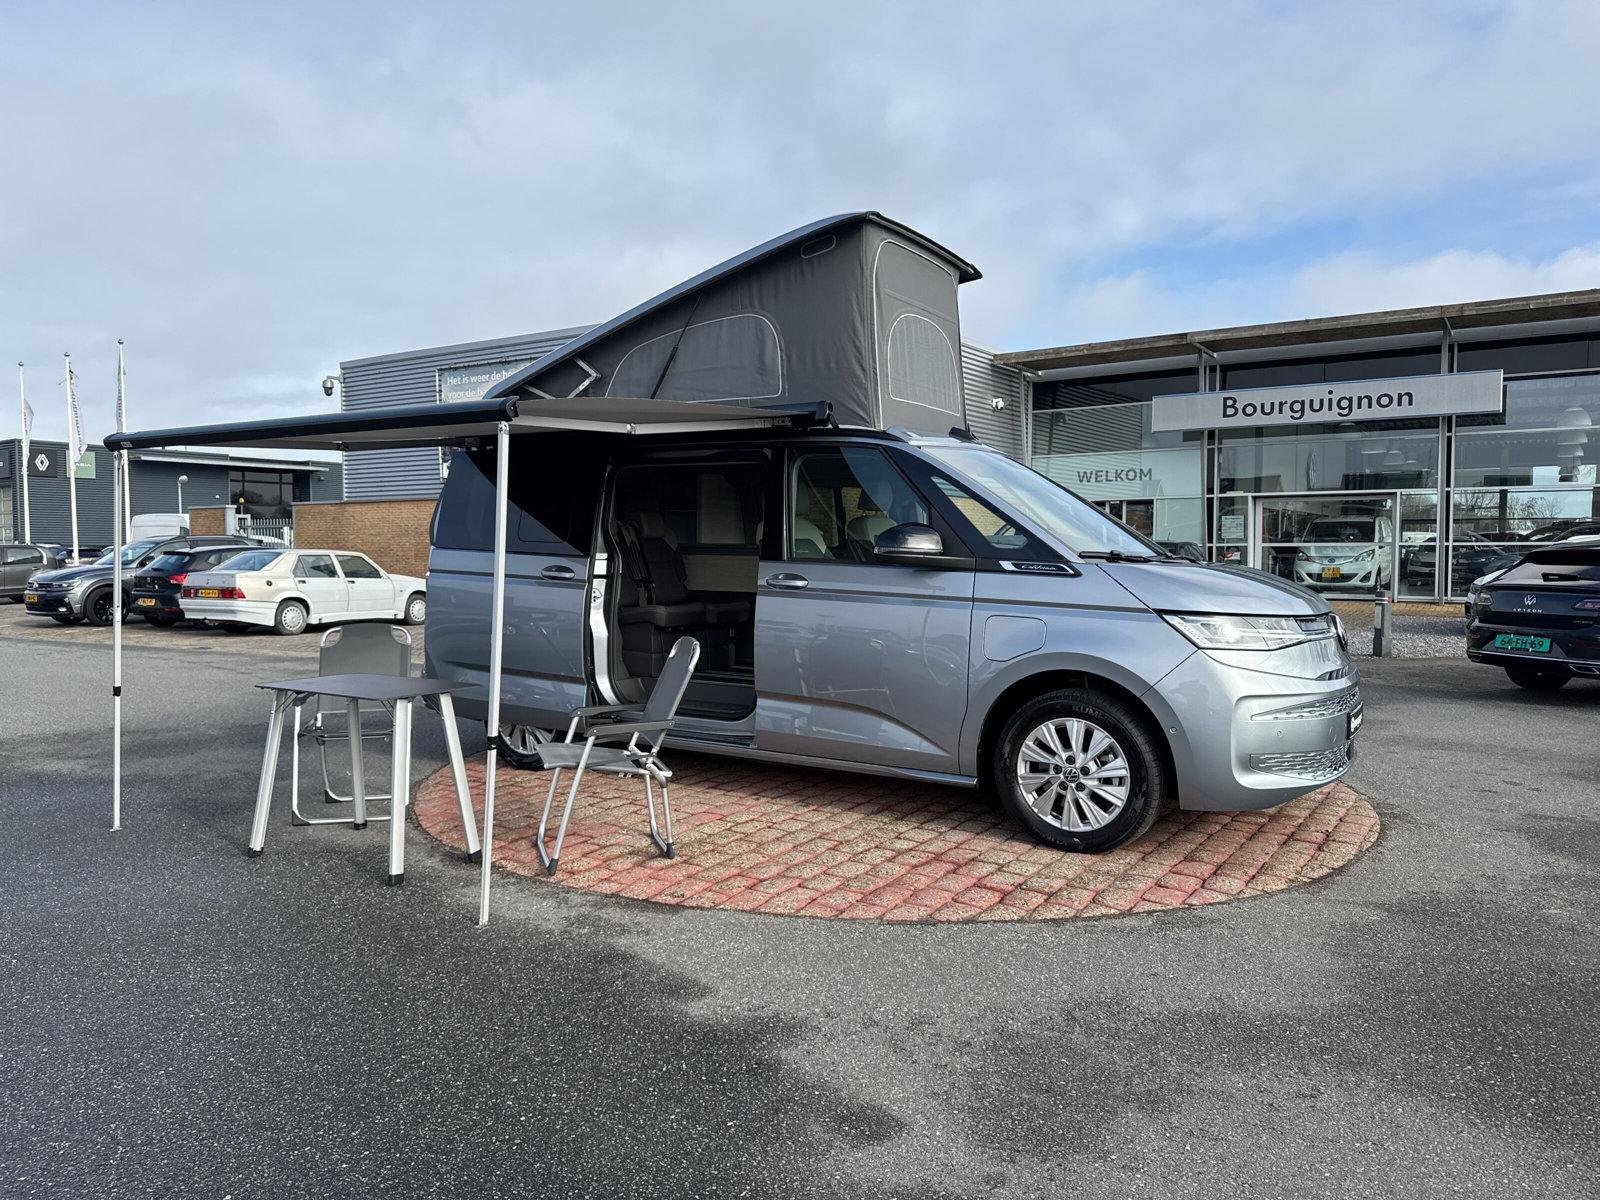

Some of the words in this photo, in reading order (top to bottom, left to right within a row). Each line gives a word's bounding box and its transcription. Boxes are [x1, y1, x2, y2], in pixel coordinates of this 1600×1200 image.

[447, 375, 461, 386] Het
[462, 374, 469, 384] is
[469, 374, 490, 383] weer
[491, 370, 501, 381] de
[447, 391, 464, 399] voor
[465, 387, 475, 398] de
[1222, 389, 1414, 420] Bourguignon
[1076, 467, 1153, 483] WELKOM
